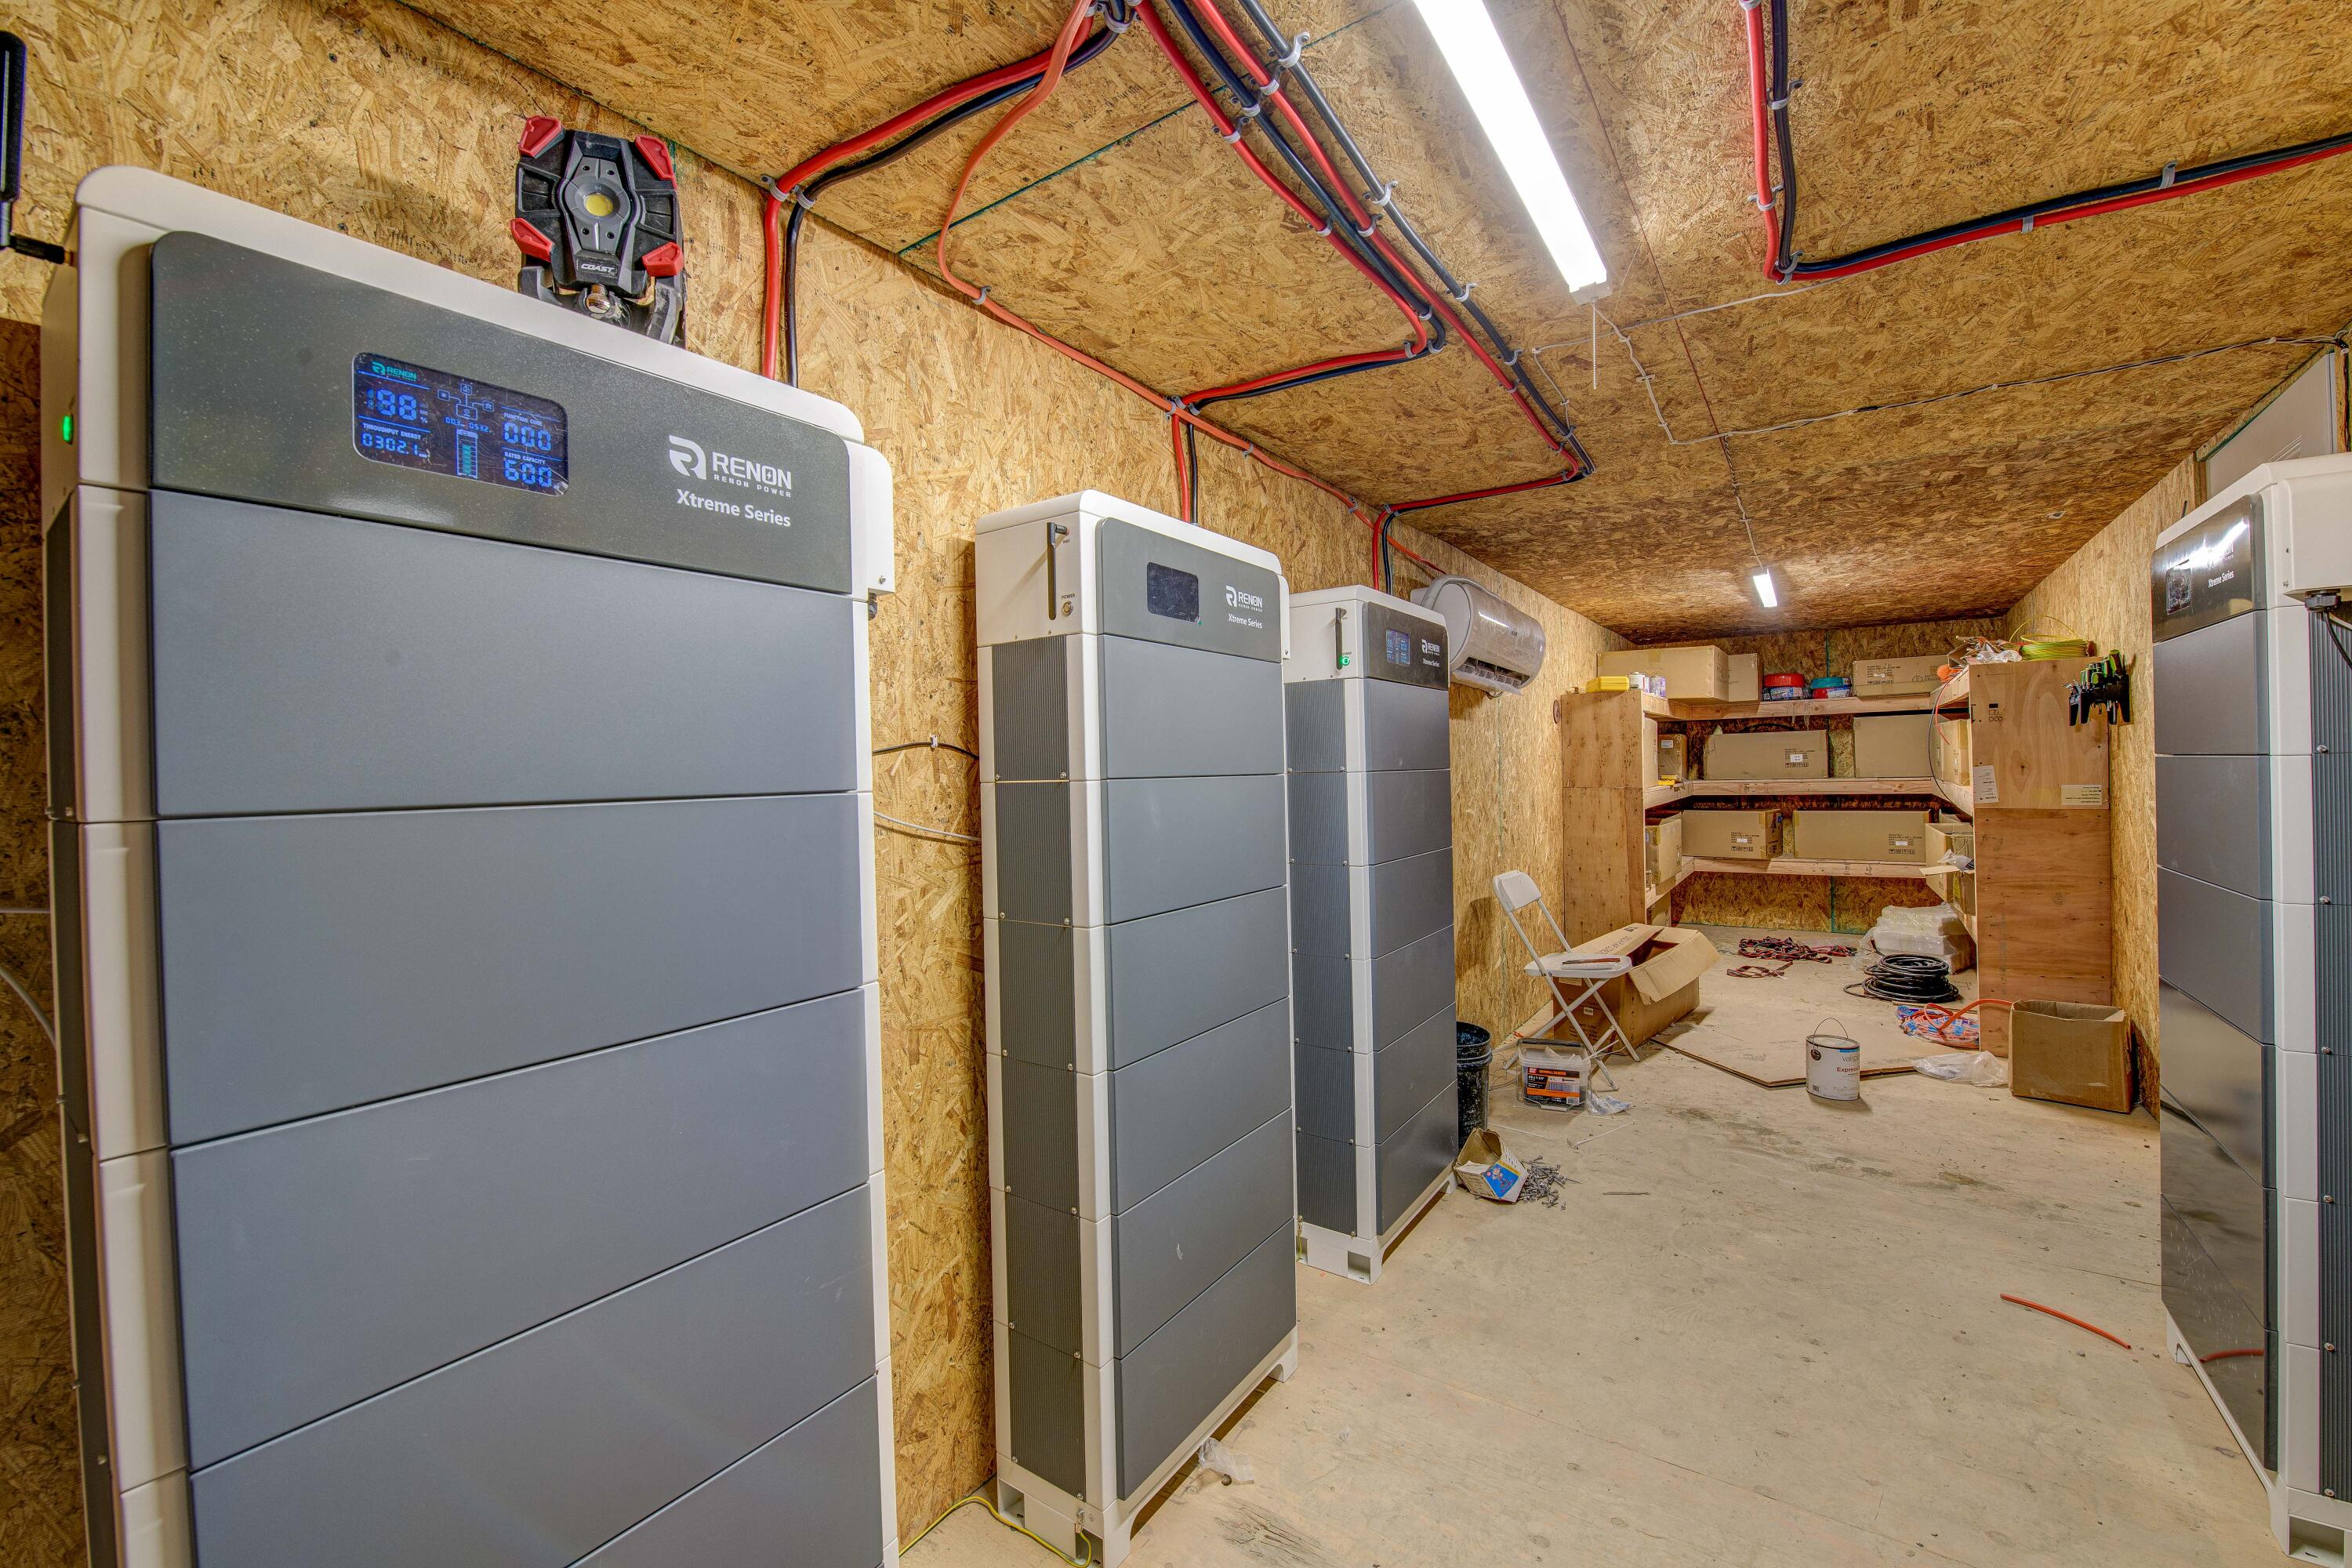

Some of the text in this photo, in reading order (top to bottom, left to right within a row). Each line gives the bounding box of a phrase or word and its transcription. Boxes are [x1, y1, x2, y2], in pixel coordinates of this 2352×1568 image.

[581, 263, 615, 273] COAST
[387, 366, 417, 380] RENON
[503, 412, 528, 423] FUNCTION
[362, 423, 421, 440] THROUGHPUT ENERGY
[503, 422, 552, 452] 000
[522, 456, 546, 465] CAPACITY
[504, 459, 553, 488] 600
[712, 452, 792, 490] RENON
[713, 474, 791, 499] RENON POWER
[677, 488, 791, 528] Xtreme Series
[2222, 571, 2234, 582] Series
[1239, 591, 1262, 608] RENON
[1229, 613, 1262, 629] Xtreme Series
